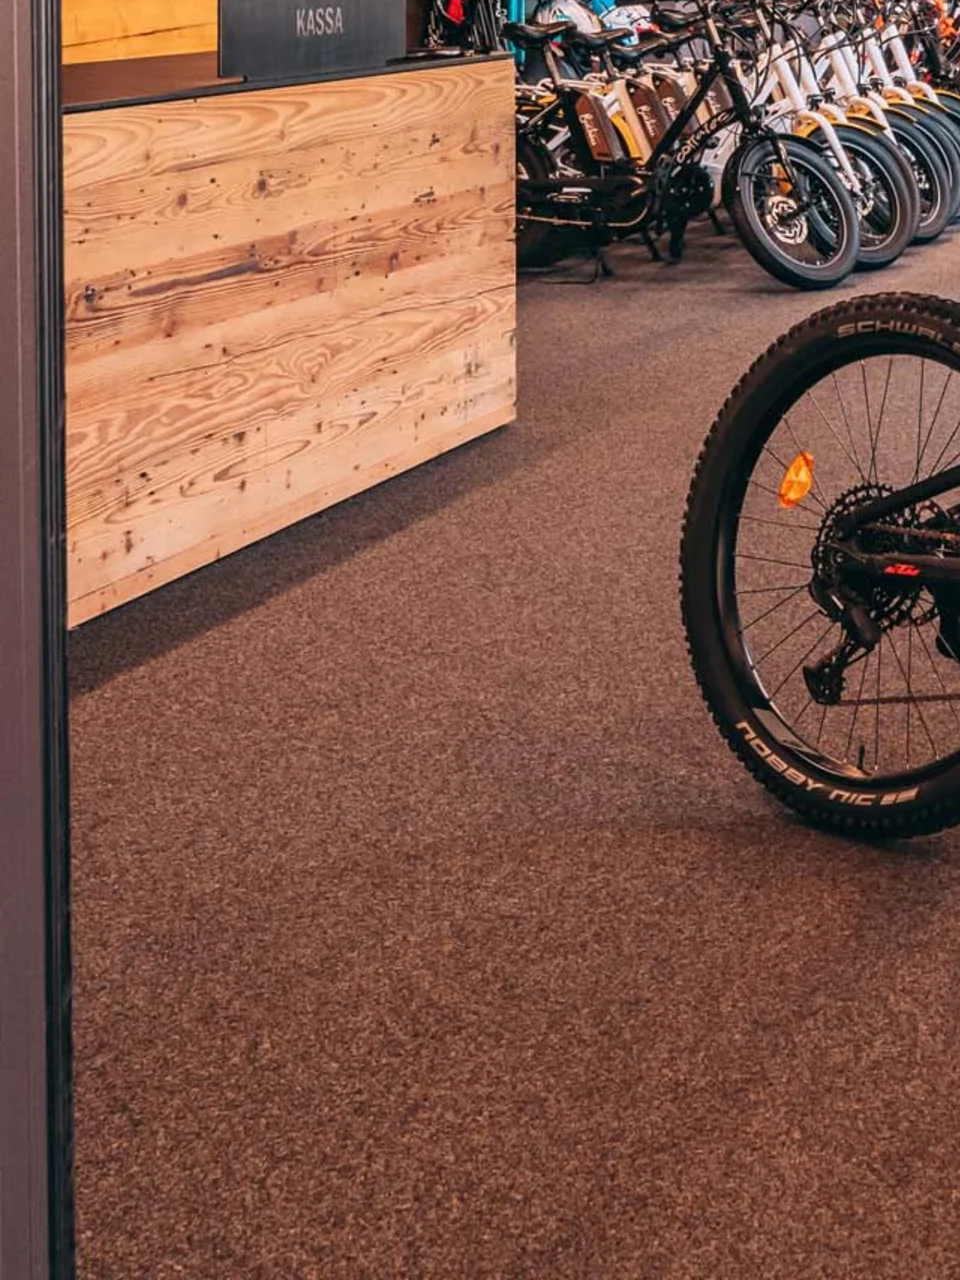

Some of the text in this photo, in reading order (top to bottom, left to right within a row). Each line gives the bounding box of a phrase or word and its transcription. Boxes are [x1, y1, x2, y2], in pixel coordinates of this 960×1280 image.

[296, 6, 343, 37] KASSA
[735, 721, 878, 807] NOBBY NIC
